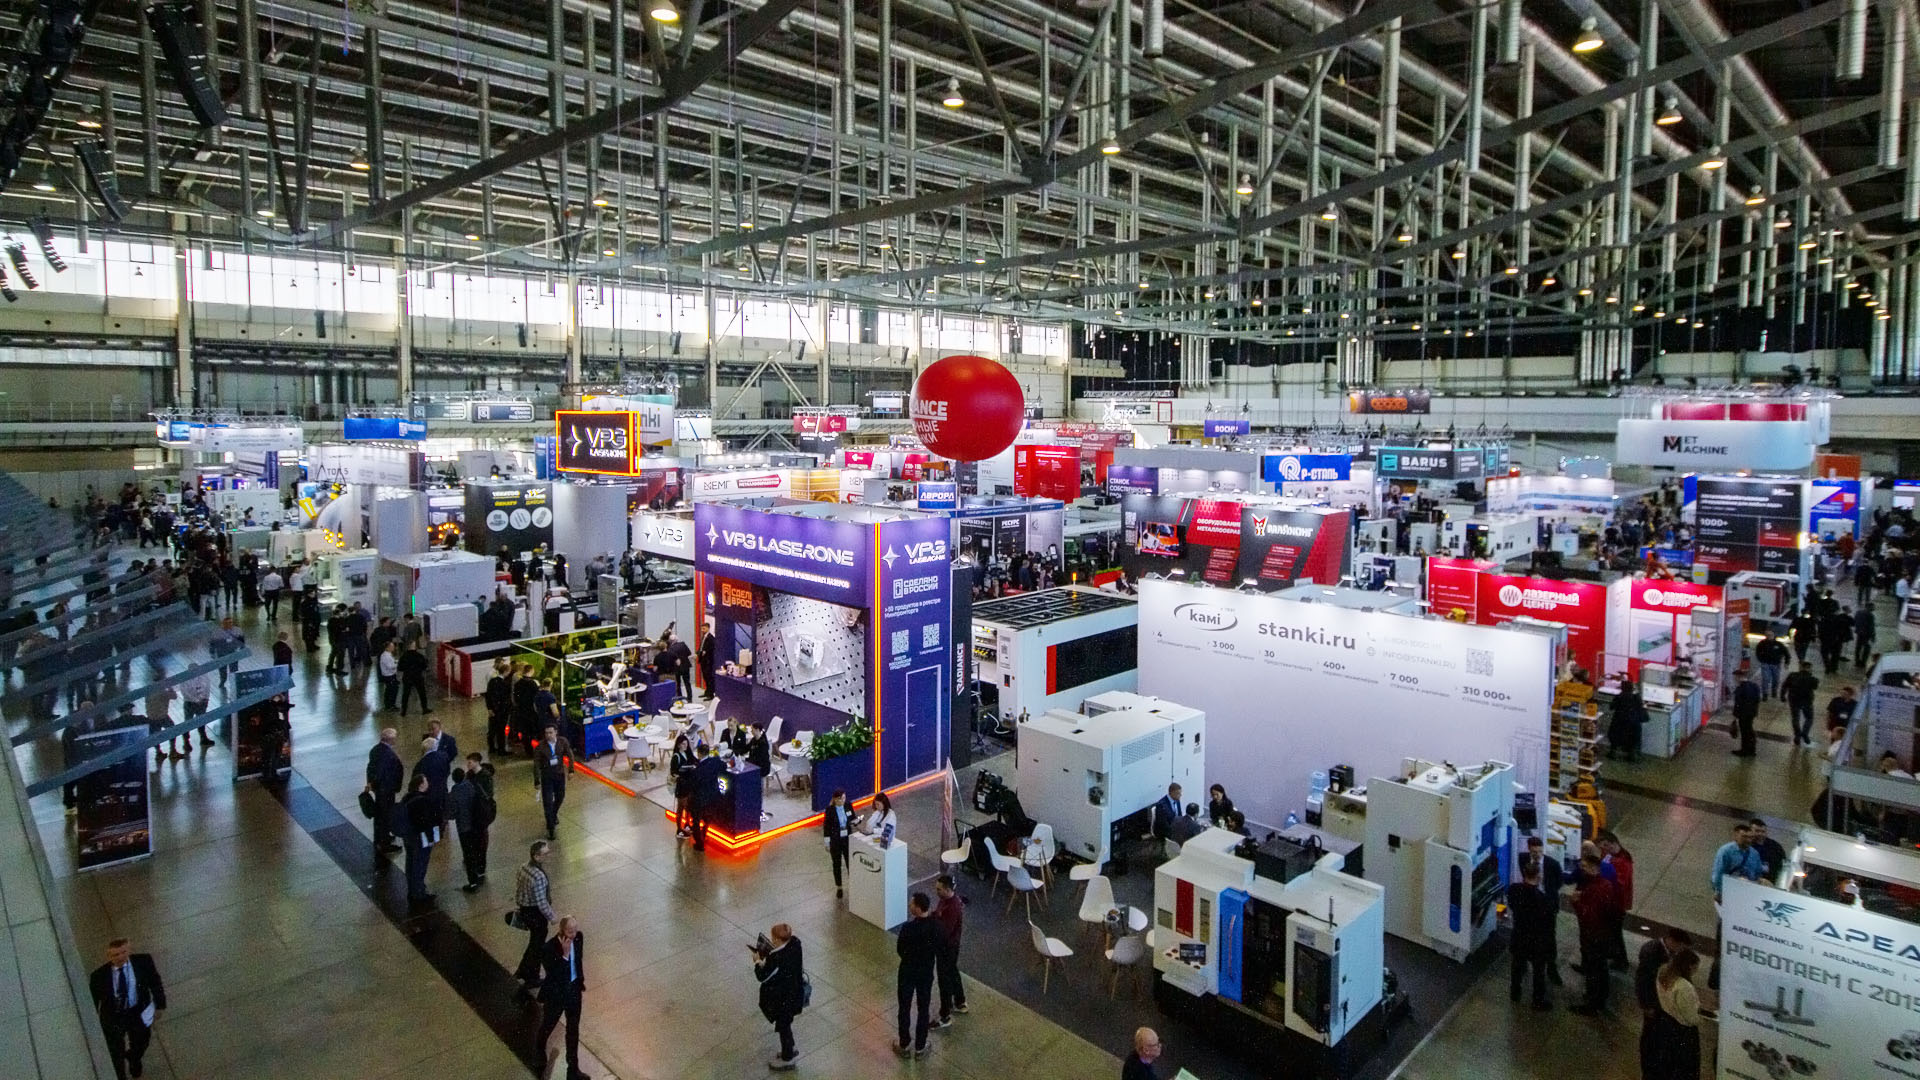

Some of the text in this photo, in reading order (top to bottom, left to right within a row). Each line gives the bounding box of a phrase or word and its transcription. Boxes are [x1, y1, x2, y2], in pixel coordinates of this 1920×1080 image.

[585, 427, 627, 449] VPG
[1401, 456, 1448, 468] BARUS
[920, 492, 954, 500] АВРОРА
[722, 530, 854, 566] VPG LASERONE
[904, 540, 946, 558] VPG
[904, 576, 938, 588] СДЕЛАНО
[910, 582, 938, 594] РОССИИ
[1523, 588, 1580, 604] ЛАЗЕРНЫЙ
[1522, 600, 1557, 610] ЦЕНТР
[1258, 622, 1356, 650] stanki.ru
[956, 642, 964, 696] RADIANCE
[1323, 660, 1346, 670] 400+
[1399, 674, 1419, 684] 000
[1463, 686, 1480, 697] 310
[1484, 690, 1512, 701] 000+
[1732, 924, 1804, 950] AREALSTANKI.RU
[1726, 940, 1841, 990] РАБОТАЕМ
[1848, 978, 1862, 996] С
[1822, 952, 1896, 977] AREALMASH.RU
